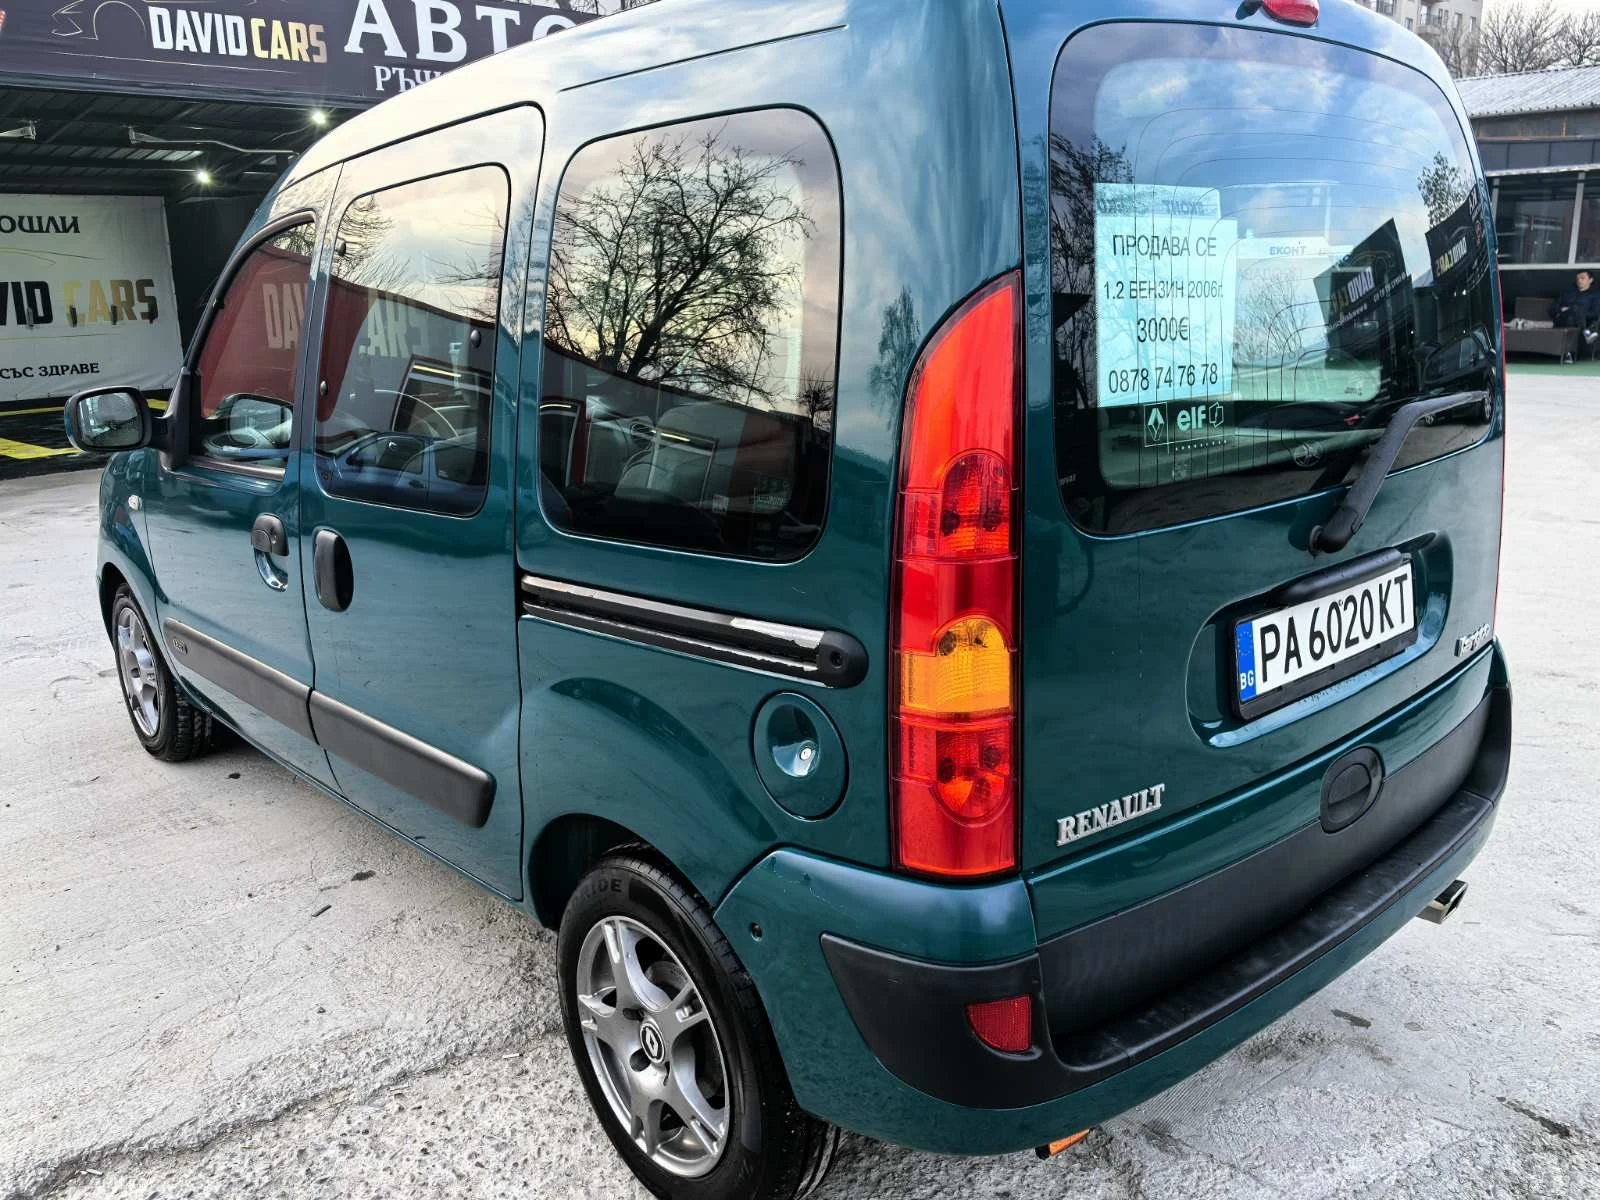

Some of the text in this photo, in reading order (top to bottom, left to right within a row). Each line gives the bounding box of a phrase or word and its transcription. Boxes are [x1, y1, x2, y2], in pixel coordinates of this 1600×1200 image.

[148, 6, 328, 64] DAVID CARS
[1112, 234, 1217, 260] ПРОДАВА СЕ
[63, 279, 159, 325] CARS
[1103, 281, 1125, 300] 1.2
[1129, 280, 1184, 300] БЕНЗИН
[1137, 316, 1190, 343] 3000€
[0, 362, 100, 379] СЪС ЗДРАВЕ
[1108, 362, 1218, 394] 0878 74 76 78
[1176, 404, 1207, 432] elf
[1240, 671, 1255, 690] BG
[1056, 782, 1166, 846] RENAULT
